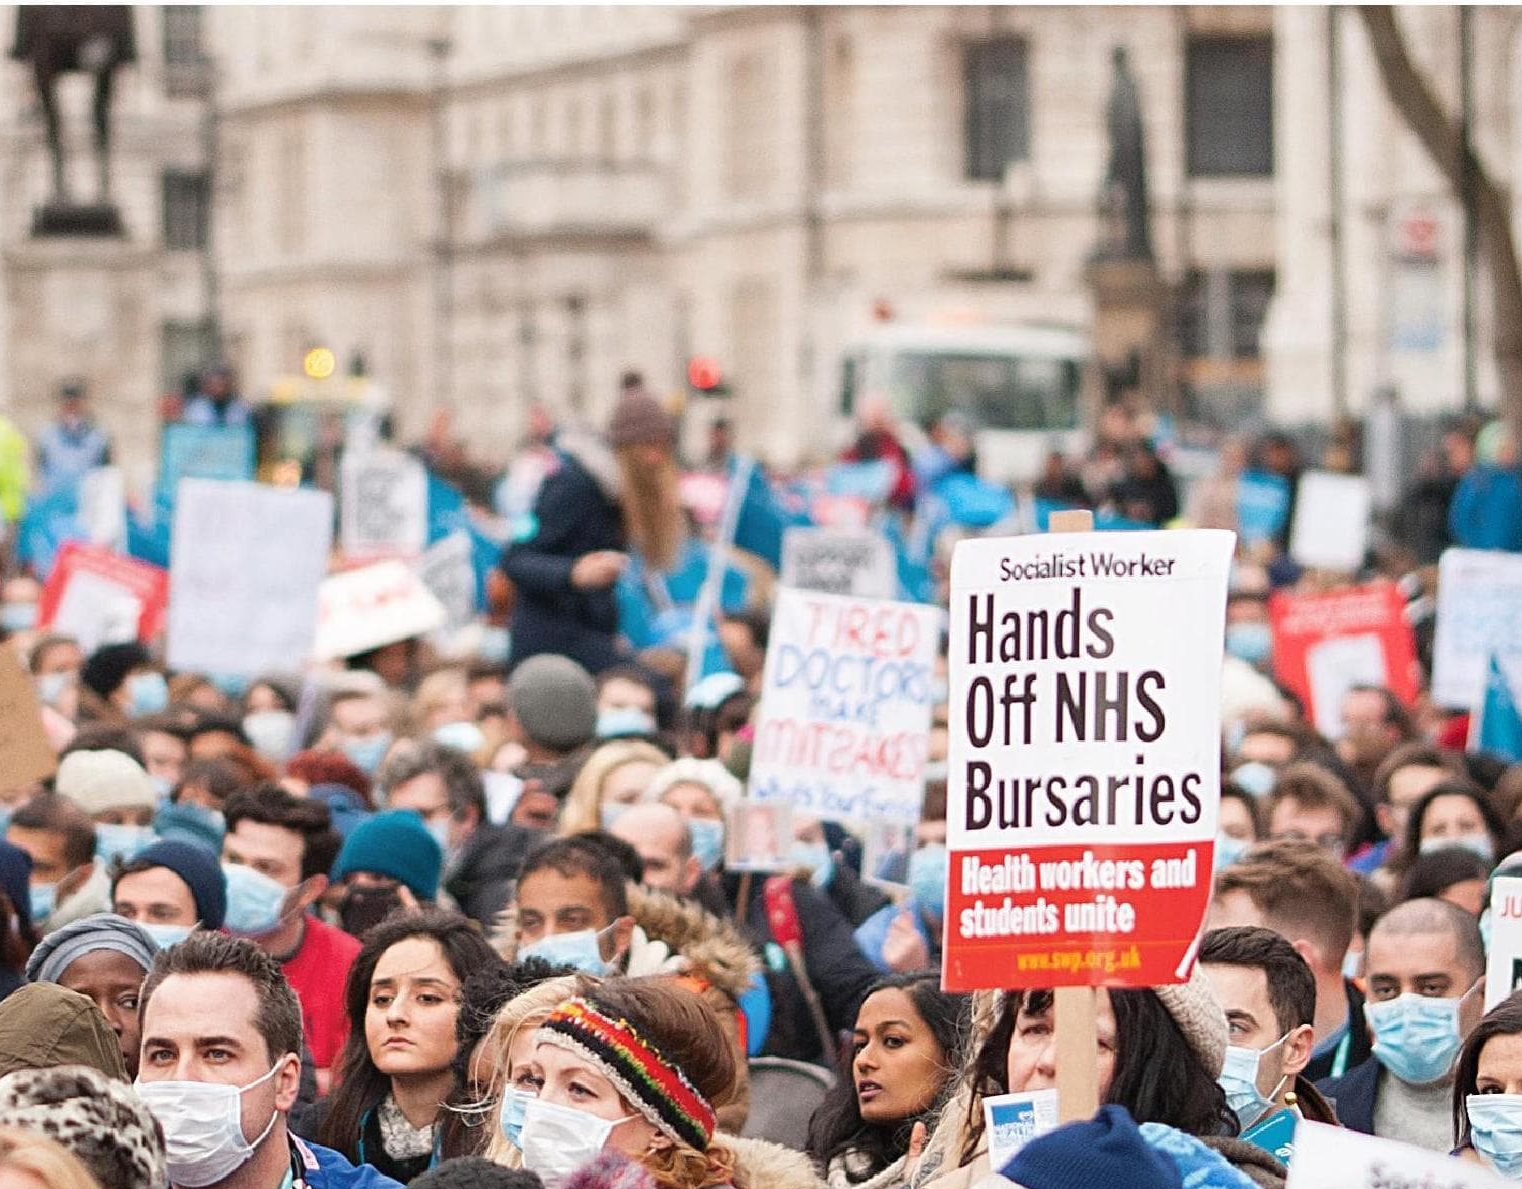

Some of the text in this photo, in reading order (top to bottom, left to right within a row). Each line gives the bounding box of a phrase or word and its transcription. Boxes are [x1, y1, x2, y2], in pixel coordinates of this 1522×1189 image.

[1000, 552, 1176, 582] Socialist Worker
[806, 601, 921, 658] TIRED
[968, 588, 1115, 665] Hands
[966, 669, 1167, 749] Off NHS
[965, 754, 1203, 832] Bursaries
[961, 849, 1197, 897] Health workers and
[959, 897, 1135, 939] students unite
